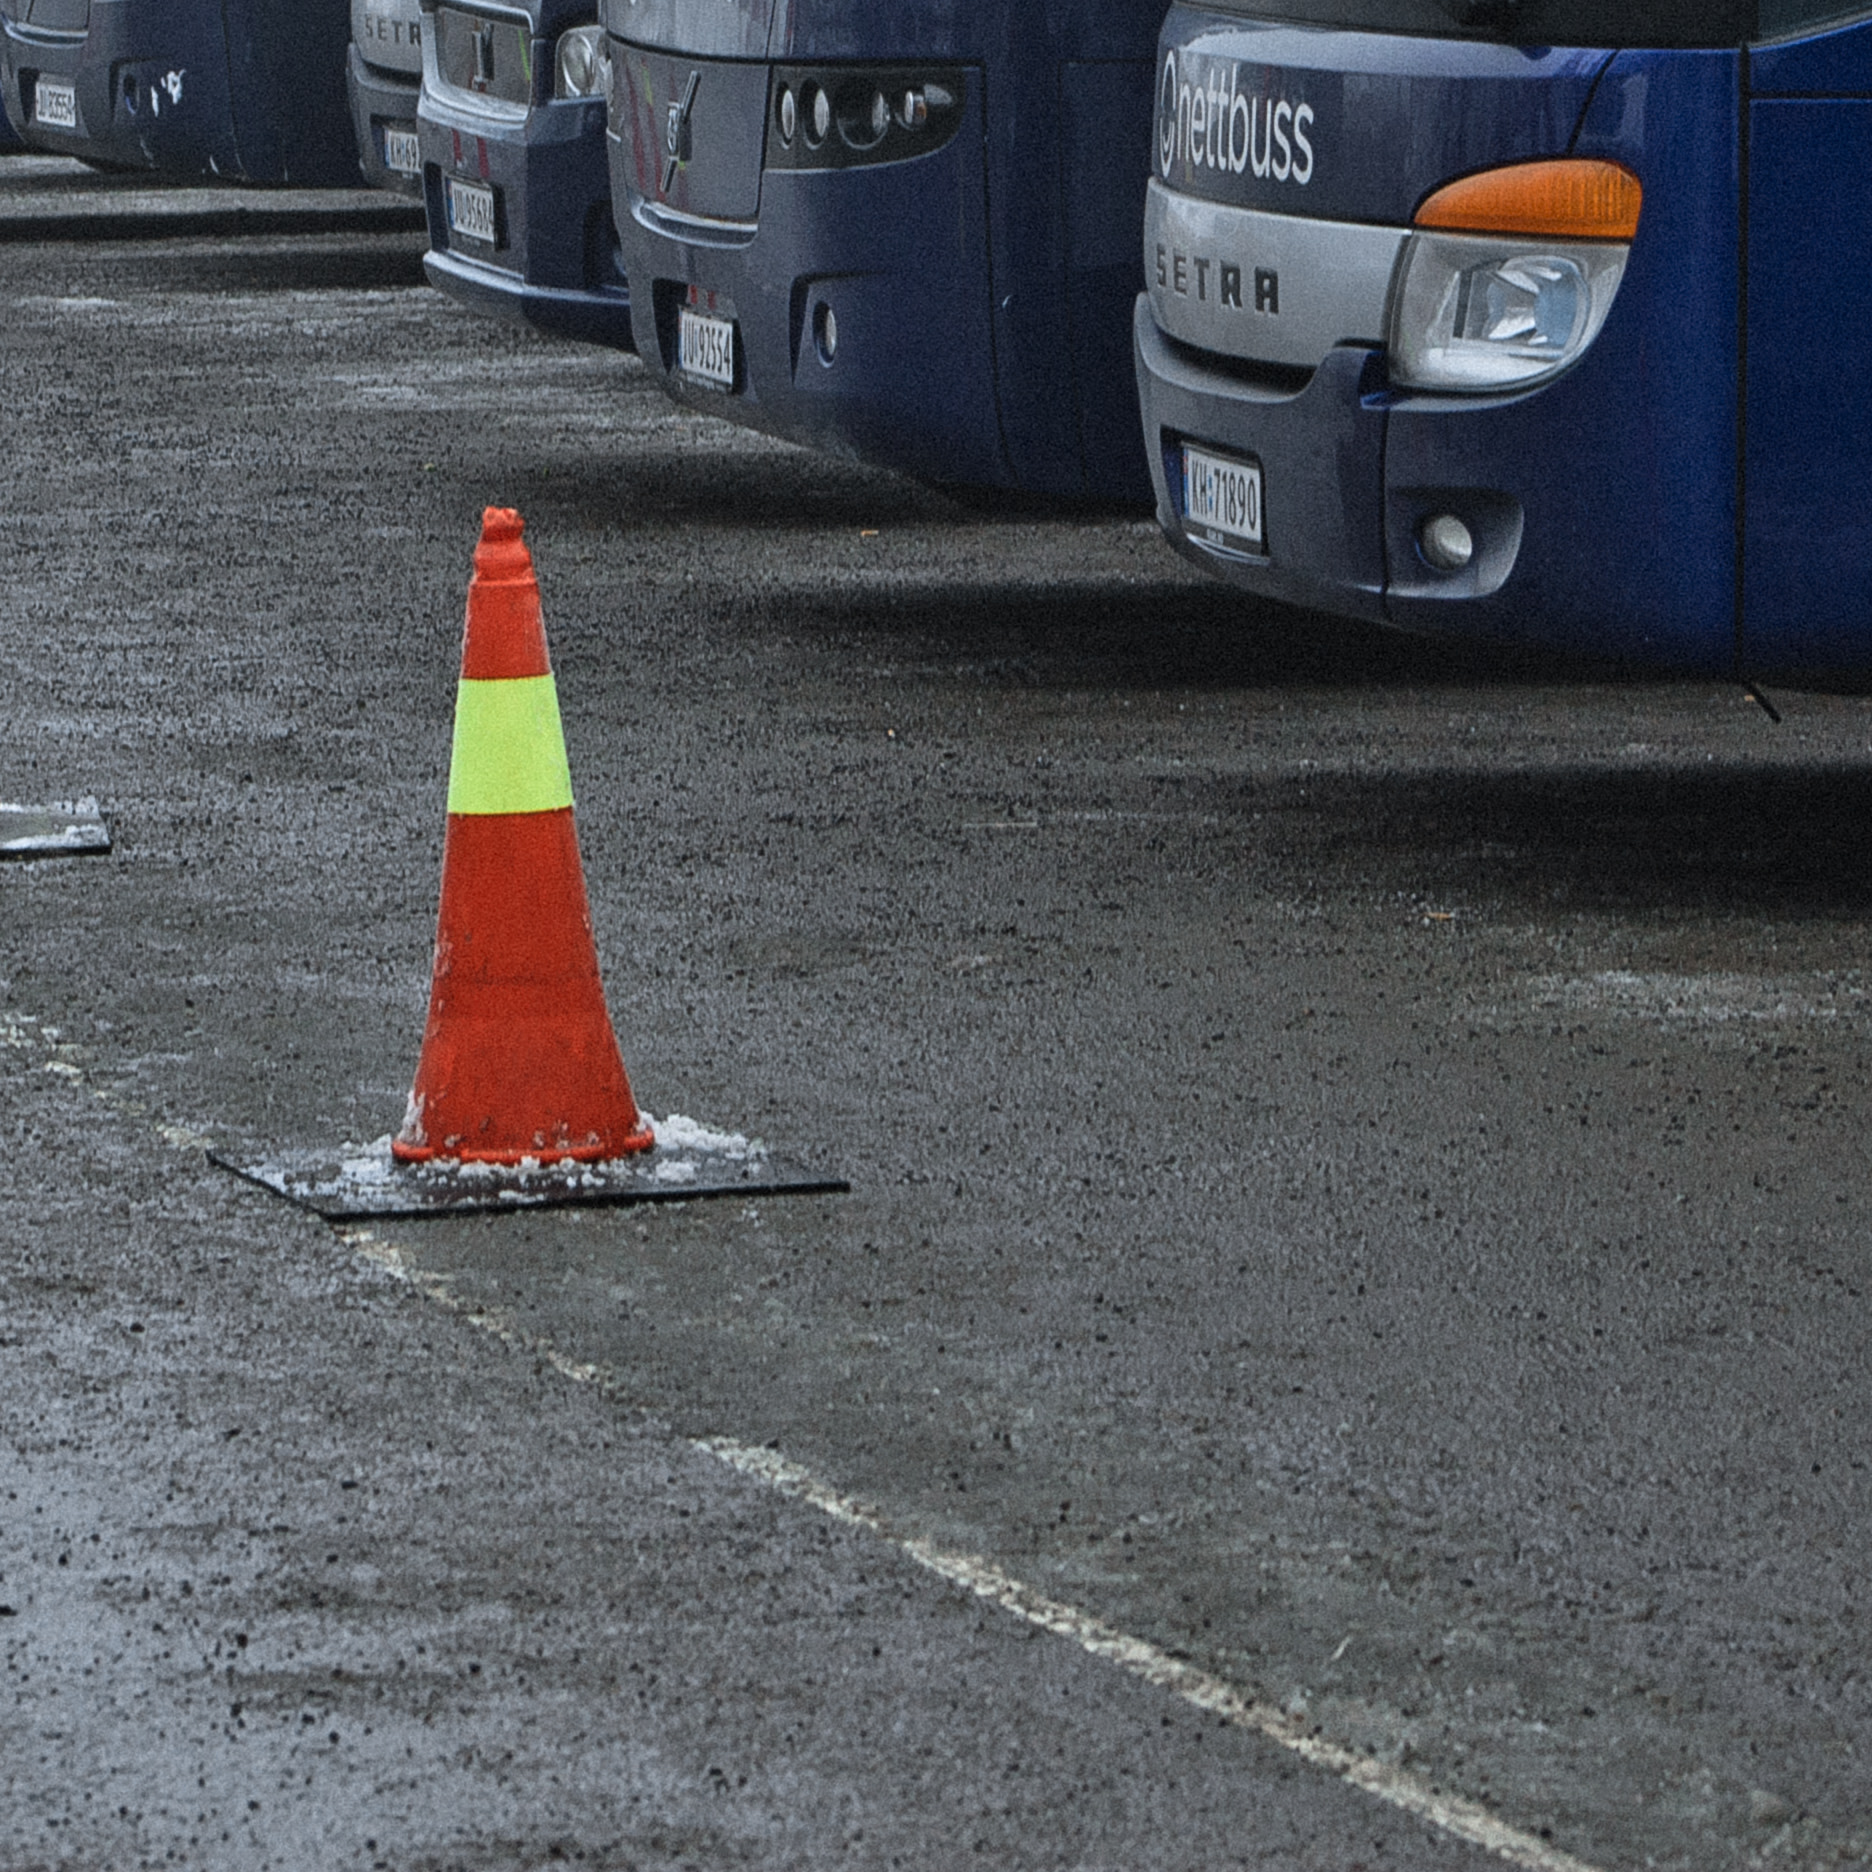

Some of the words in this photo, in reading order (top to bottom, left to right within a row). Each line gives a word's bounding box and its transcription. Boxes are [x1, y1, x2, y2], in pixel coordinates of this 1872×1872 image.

[364, 13, 421, 47] SETR
[1176, 62, 1315, 186] nettbuss
[1157, 243, 1280, 315] SETRA
[1192, 459, 1208, 516] KH
[1214, 468, 1257, 531] 71890
